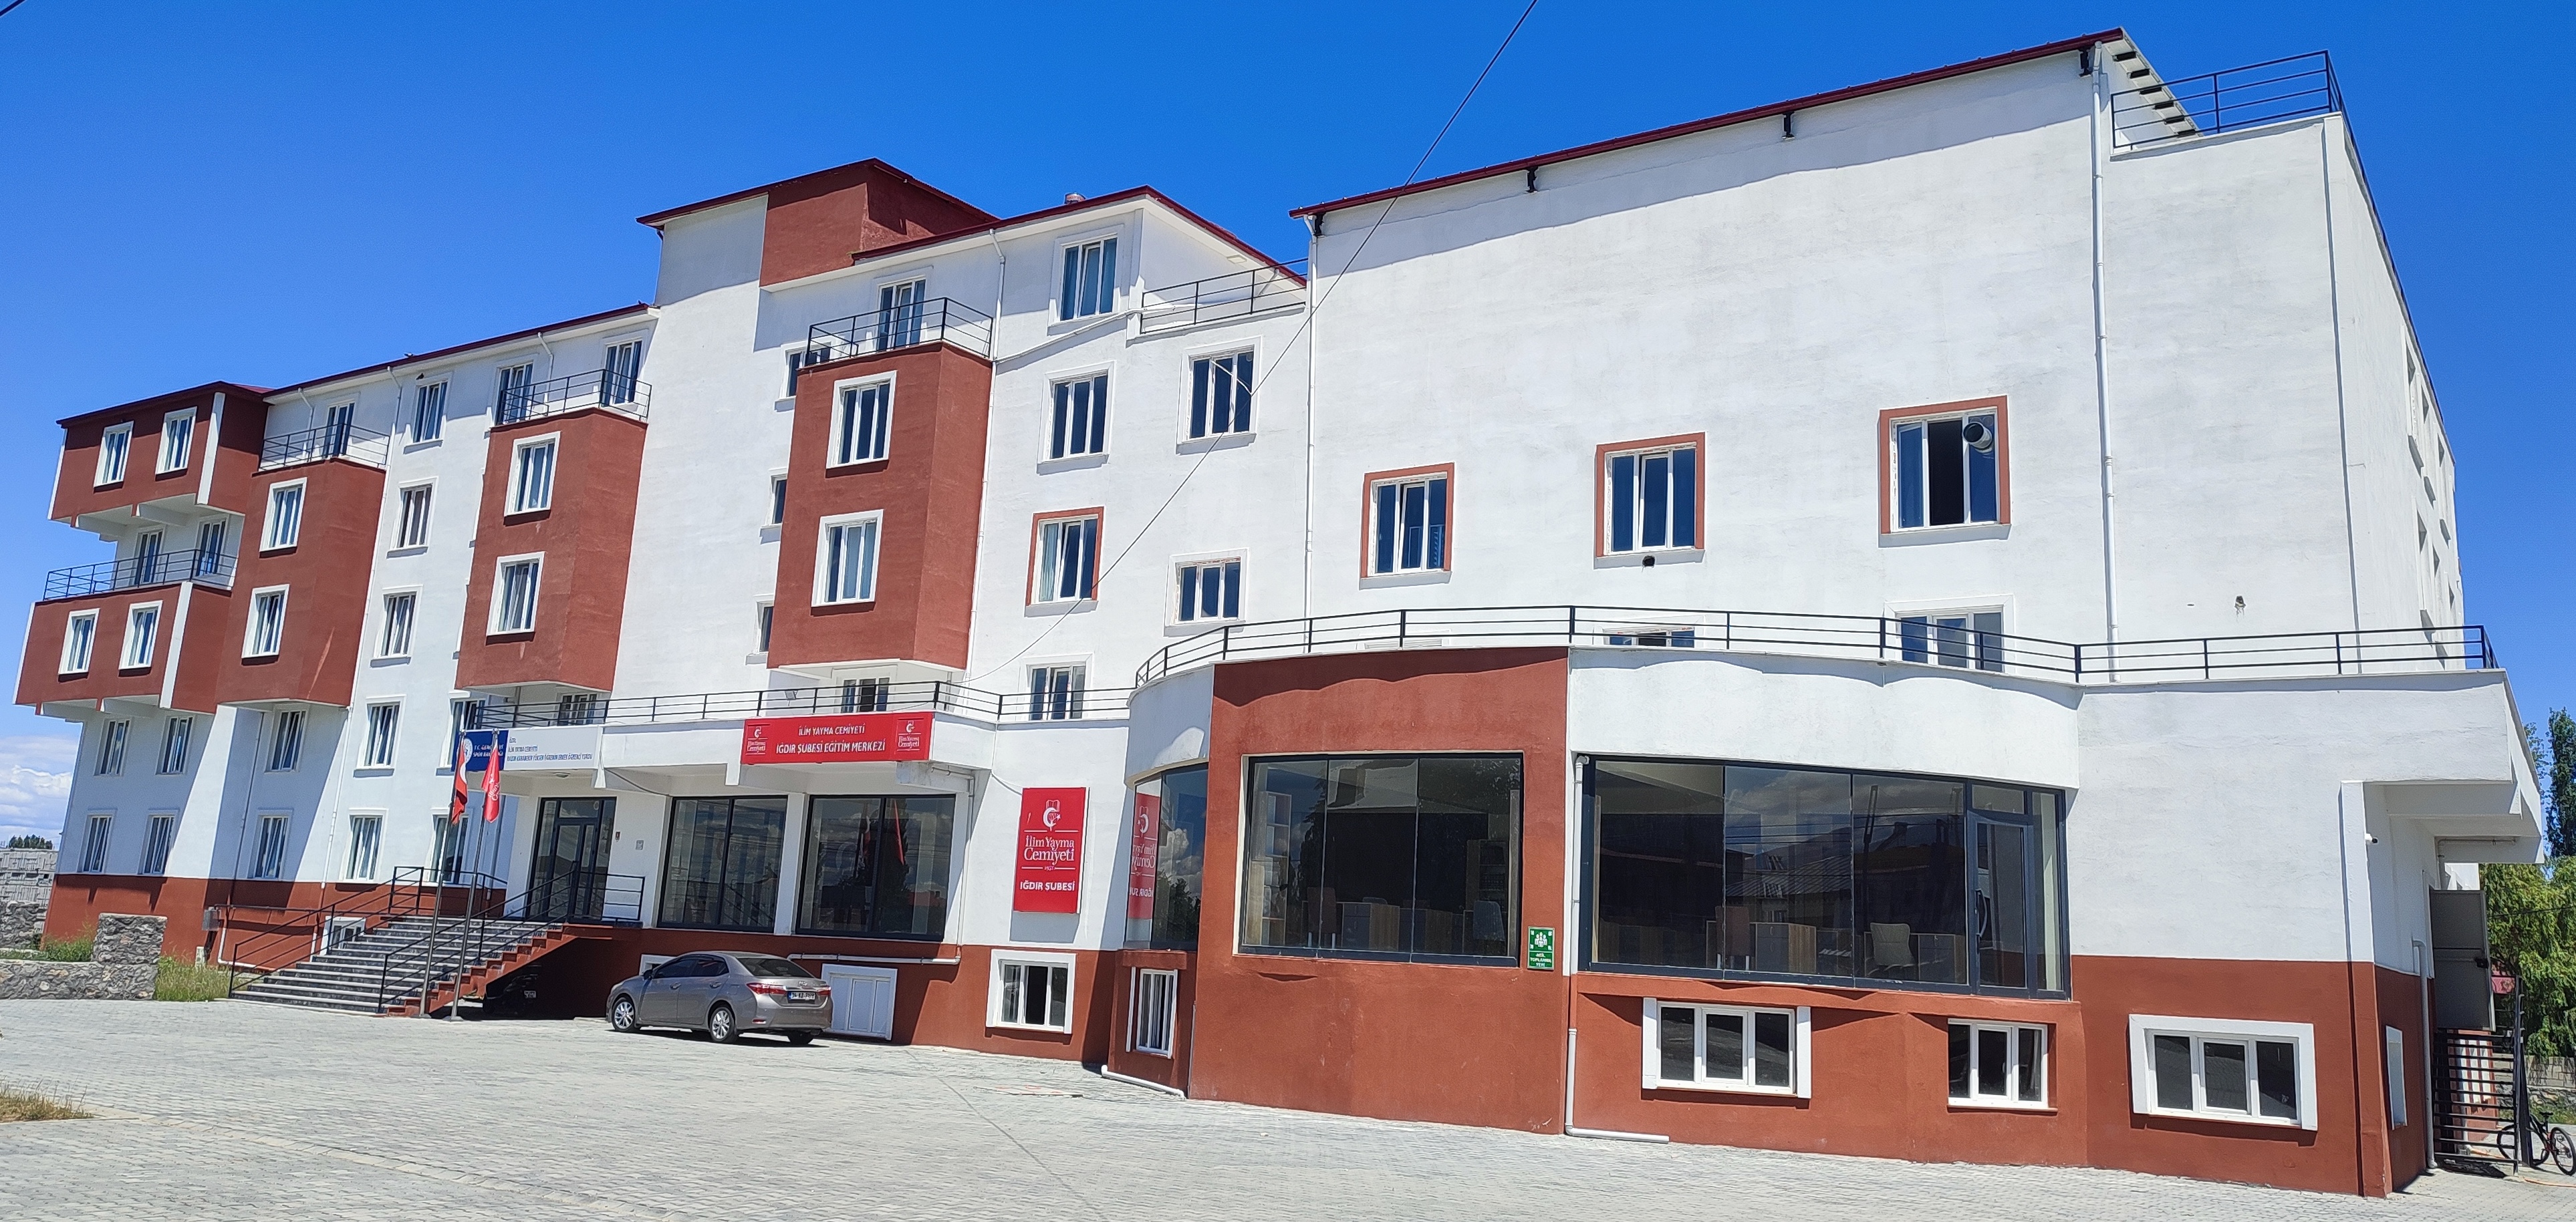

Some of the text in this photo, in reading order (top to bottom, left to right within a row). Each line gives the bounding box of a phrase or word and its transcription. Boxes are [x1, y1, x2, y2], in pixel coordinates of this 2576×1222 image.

[798, 723, 866, 736] İLİM YAYMA CEMİYETİ
[797, 740, 823, 755] ŞUBESİ
[823, 739, 851, 753] EĞİTİM
[851, 738, 886, 752] MERKEZİ
[1045, 836, 1074, 851] Yayma
[1023, 847, 1075, 865] Cemiyeti
[1020, 879, 1075, 892] IĞDIR ŞUBESİ
